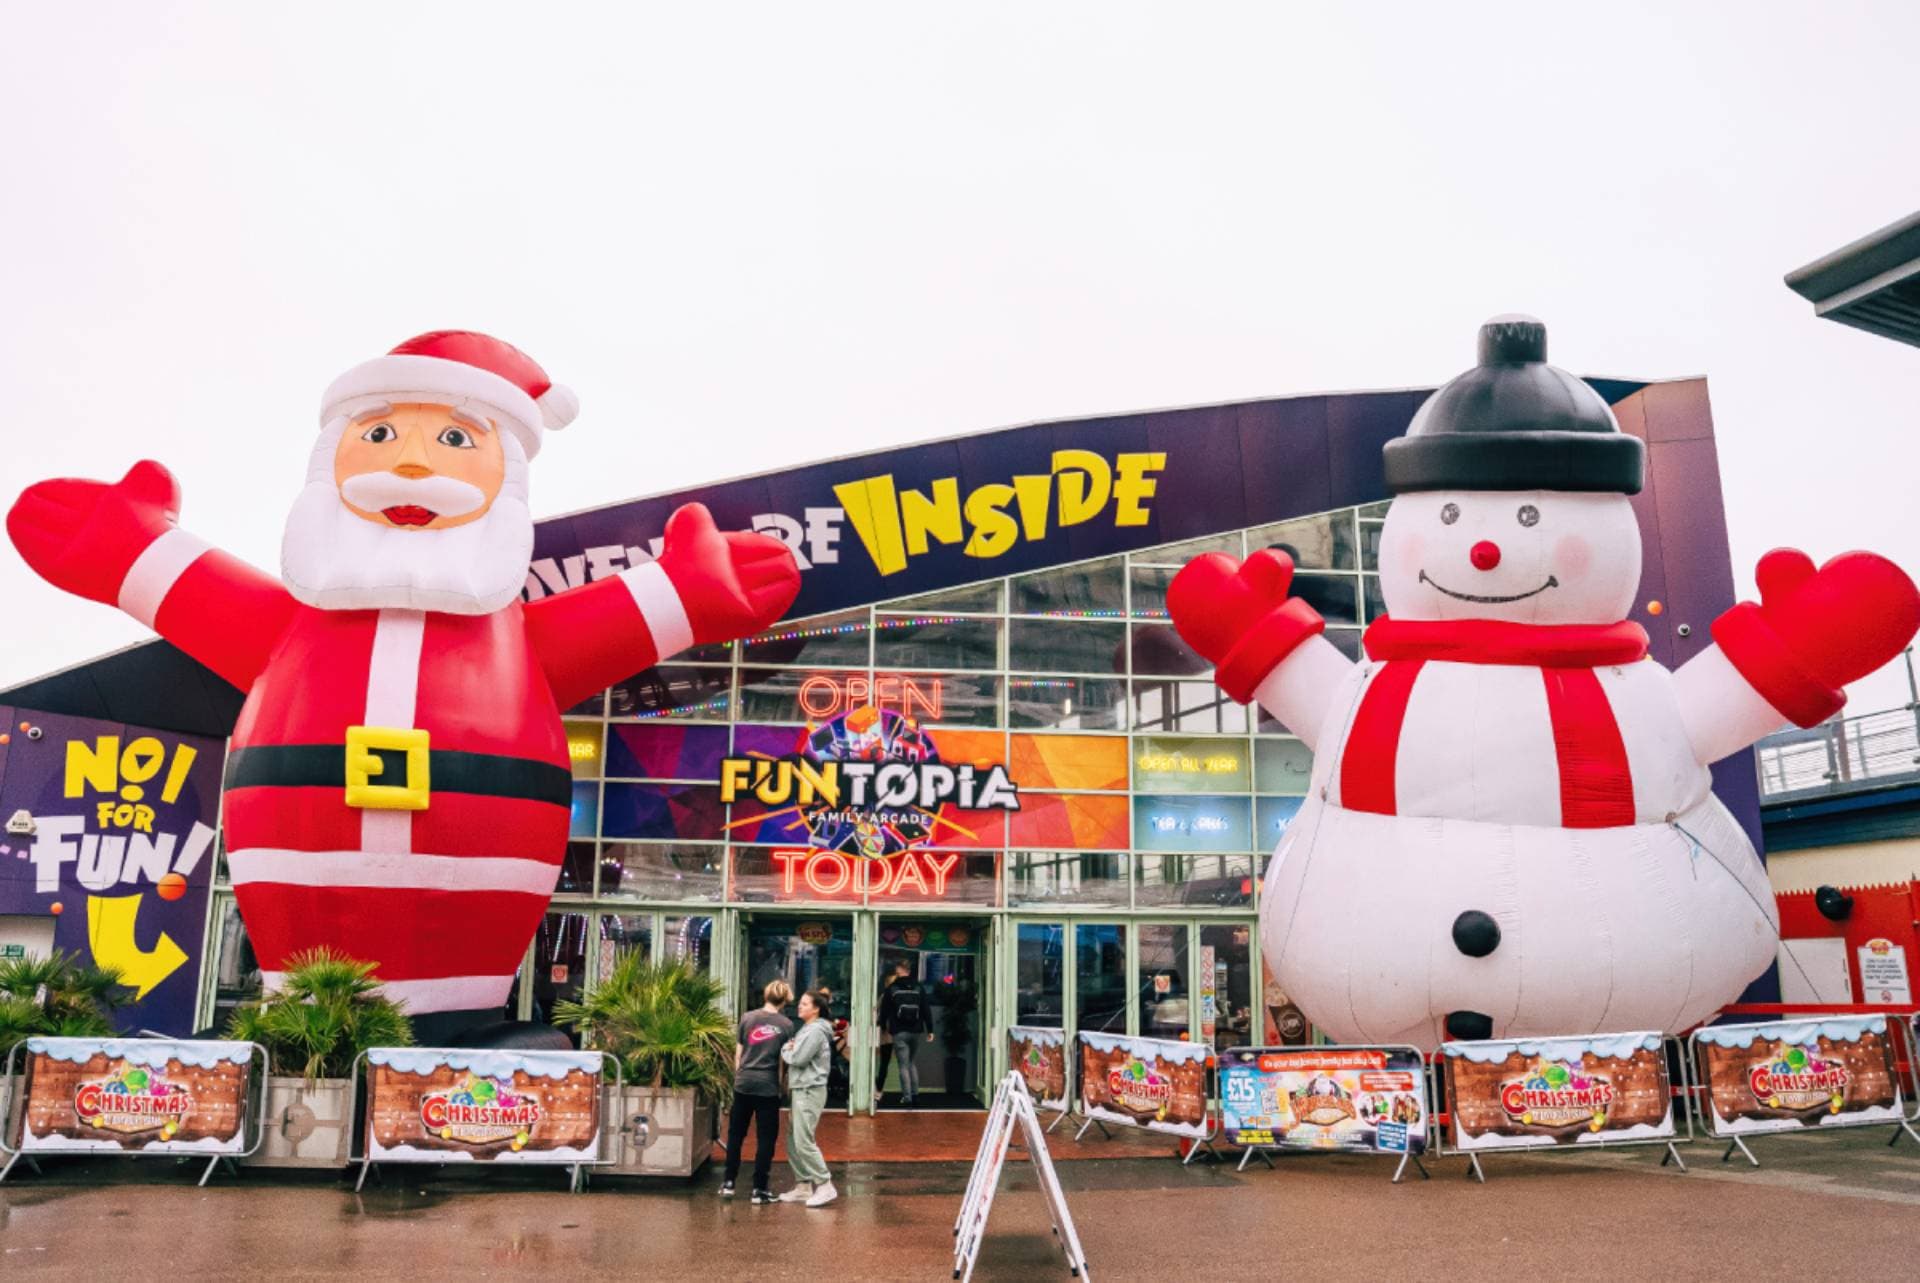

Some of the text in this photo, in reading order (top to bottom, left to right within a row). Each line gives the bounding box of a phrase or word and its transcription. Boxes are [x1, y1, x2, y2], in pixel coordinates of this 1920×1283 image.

[832, 449, 1167, 577] INSIDE
[799, 676, 942, 719] OPEN
[1139, 757, 1179, 772] OPEN
[1181, 757, 1200, 772] ALL
[720, 757, 1020, 810] FUNTOPIA
[96, 801, 156, 833] FOR
[808, 811, 929, 825] FAMILY ARCADE
[29, 815, 217, 898] FUN!
[773, 851, 959, 895] TODAY
[1227, 1077, 1255, 1102] £15
[1501, 1083, 1614, 1114] CHRISTMAS
[1751, 1067, 1848, 1099] CHRISTMAS
[75, 1085, 190, 1117] CHRISTMAS
[421, 1096, 539, 1127] CHRISTMAS
